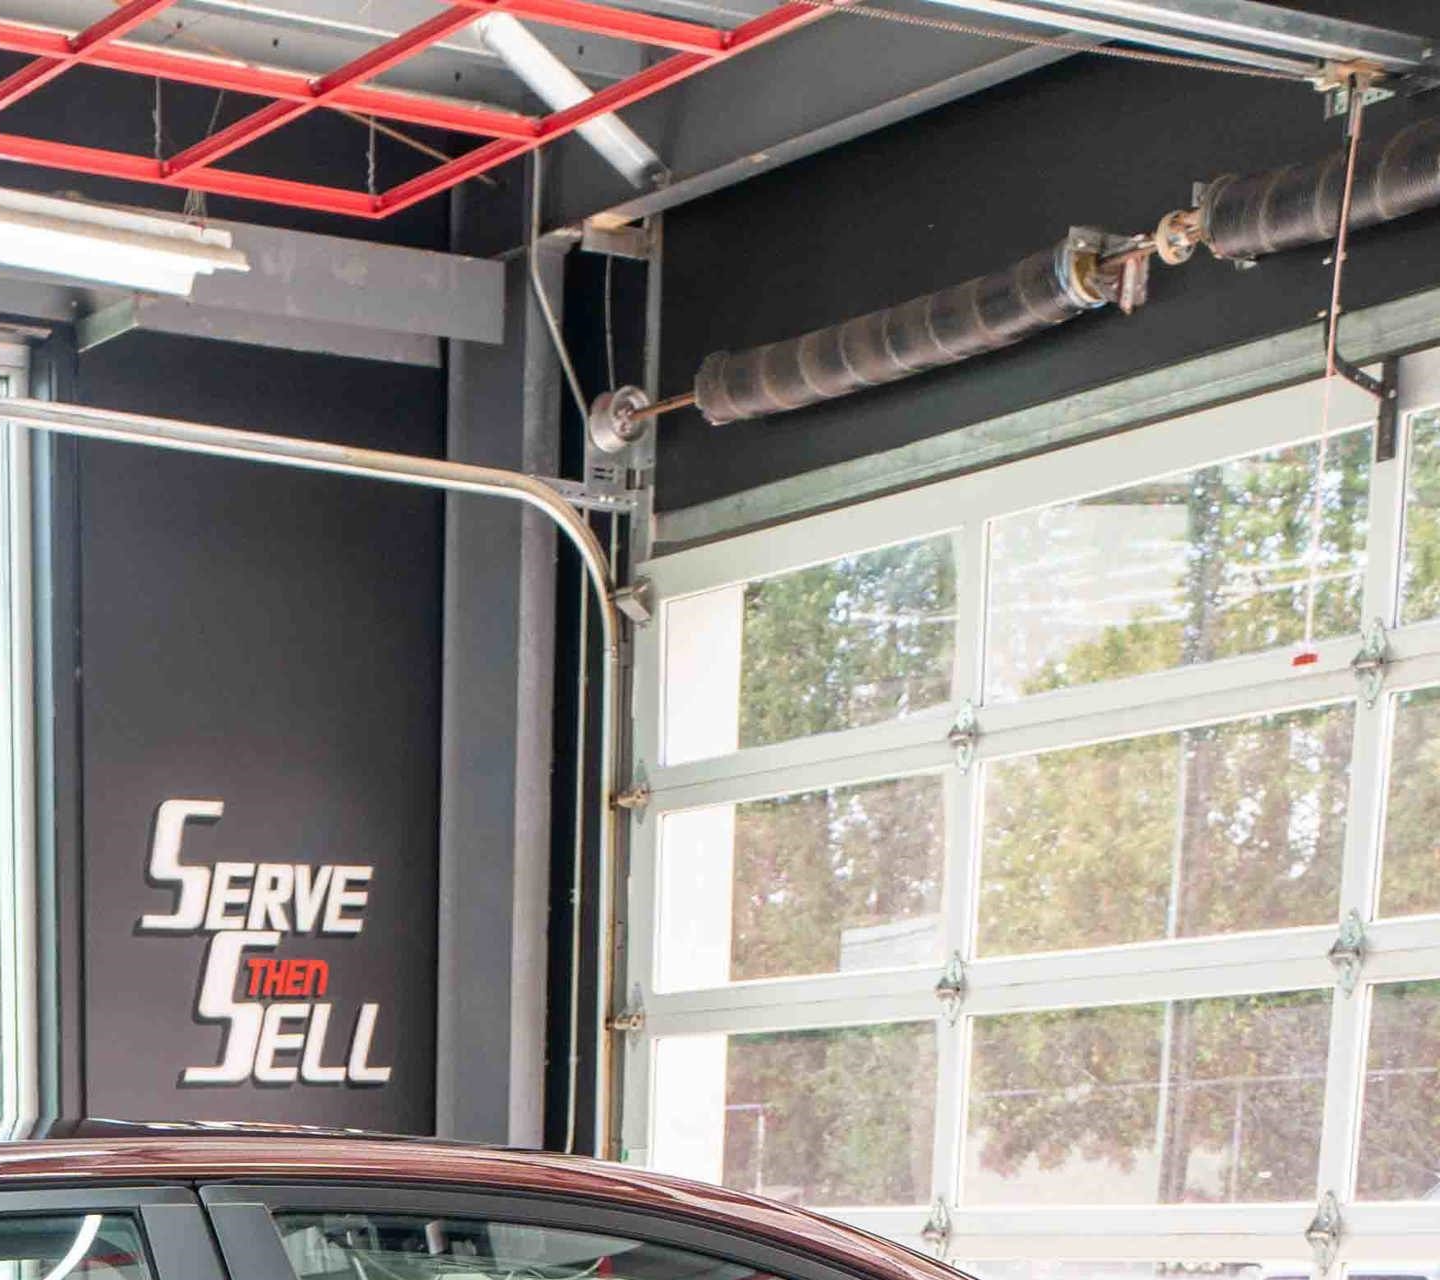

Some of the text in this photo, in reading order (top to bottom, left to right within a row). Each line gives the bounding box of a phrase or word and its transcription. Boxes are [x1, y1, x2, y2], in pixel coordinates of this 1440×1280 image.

[139, 798, 374, 933] SERVE
[181, 930, 392, 1084] SELL
[246, 959, 330, 997] THEN
